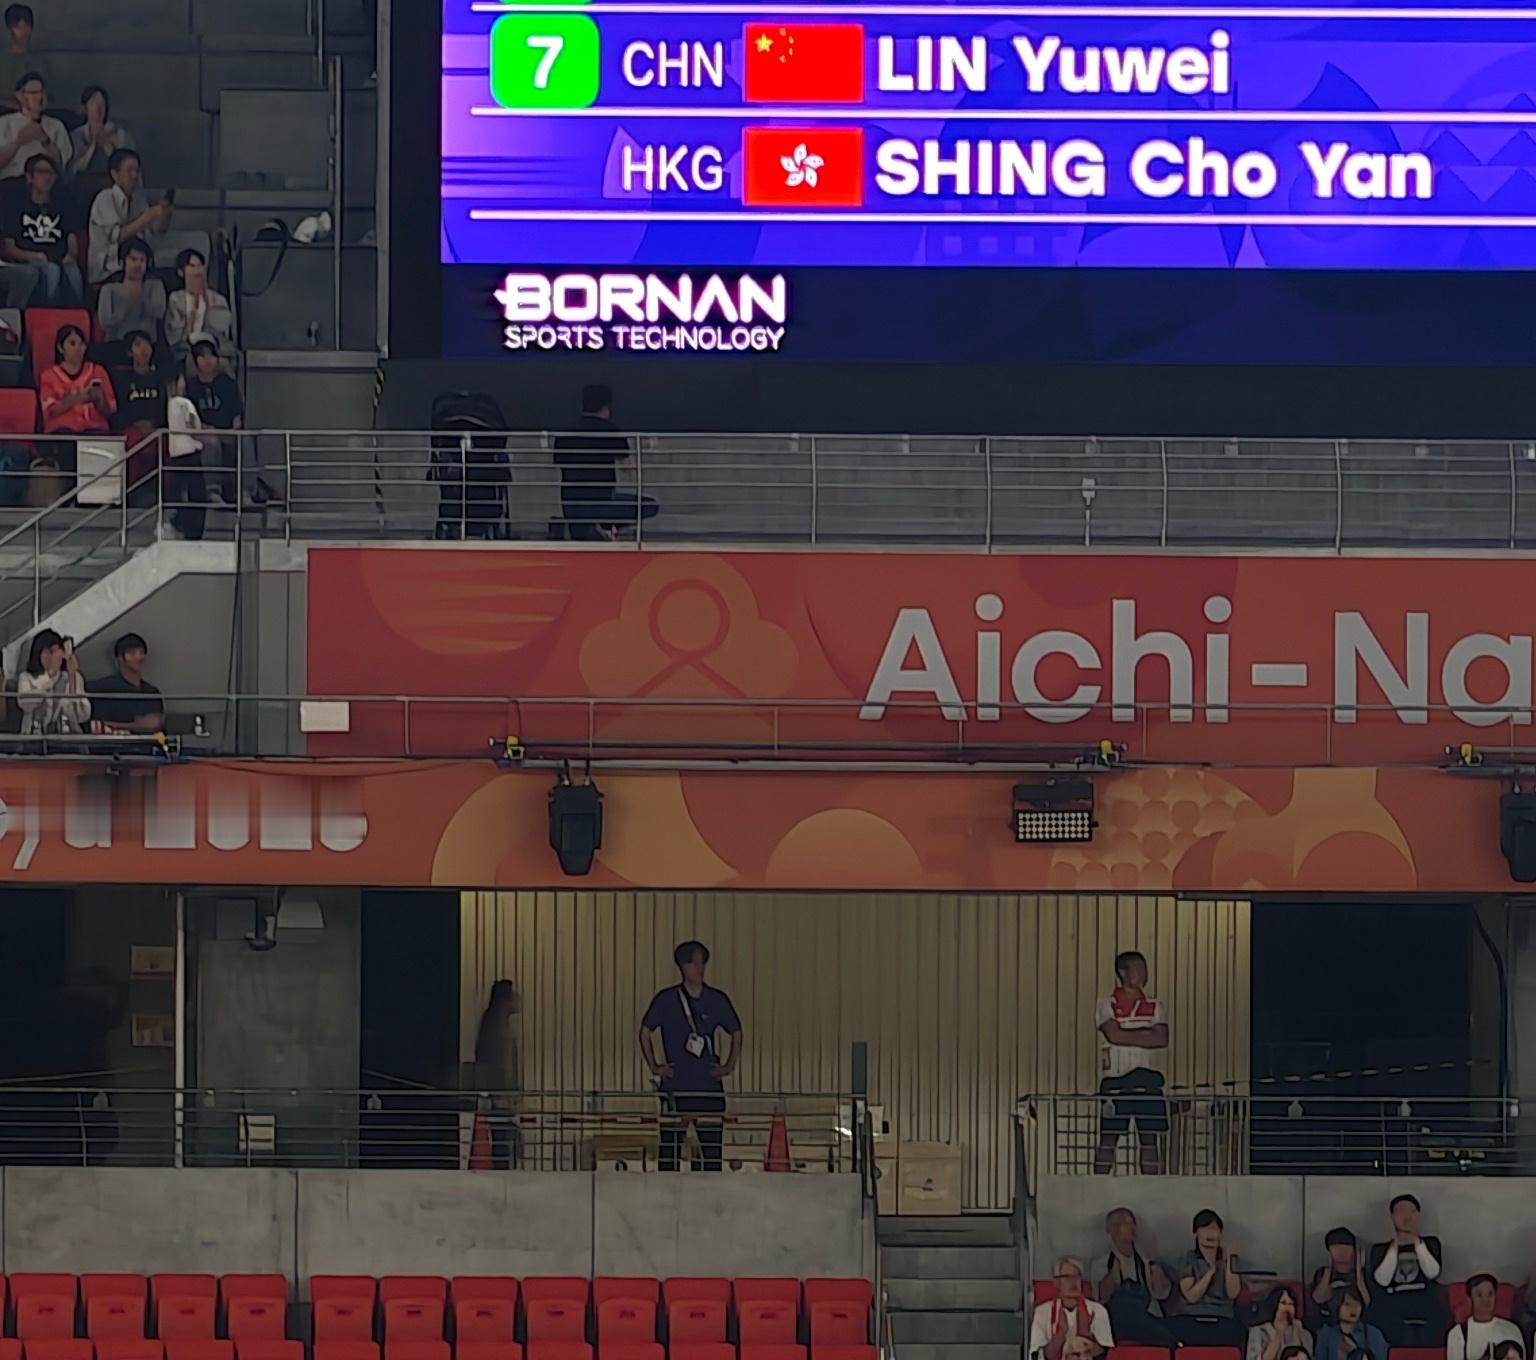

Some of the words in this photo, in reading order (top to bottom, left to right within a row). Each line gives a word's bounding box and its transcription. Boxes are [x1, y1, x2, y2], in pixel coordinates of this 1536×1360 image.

[528, 37, 562, 87] 7
[624, 42, 722, 86] CHN
[879, 37, 985, 91] LIN
[1014, 31, 1228, 93] Yuwei
[624, 146, 722, 190] HKG
[876, 140, 1104, 196] SHING
[1132, 138, 1276, 197] Cho
[1301, 143, 1431, 198] Yan
[495, 275, 785, 322] BORNAN
[506, 325, 603, 349] SPORTS
[613, 326, 784, 350] TECHNOLOGY
